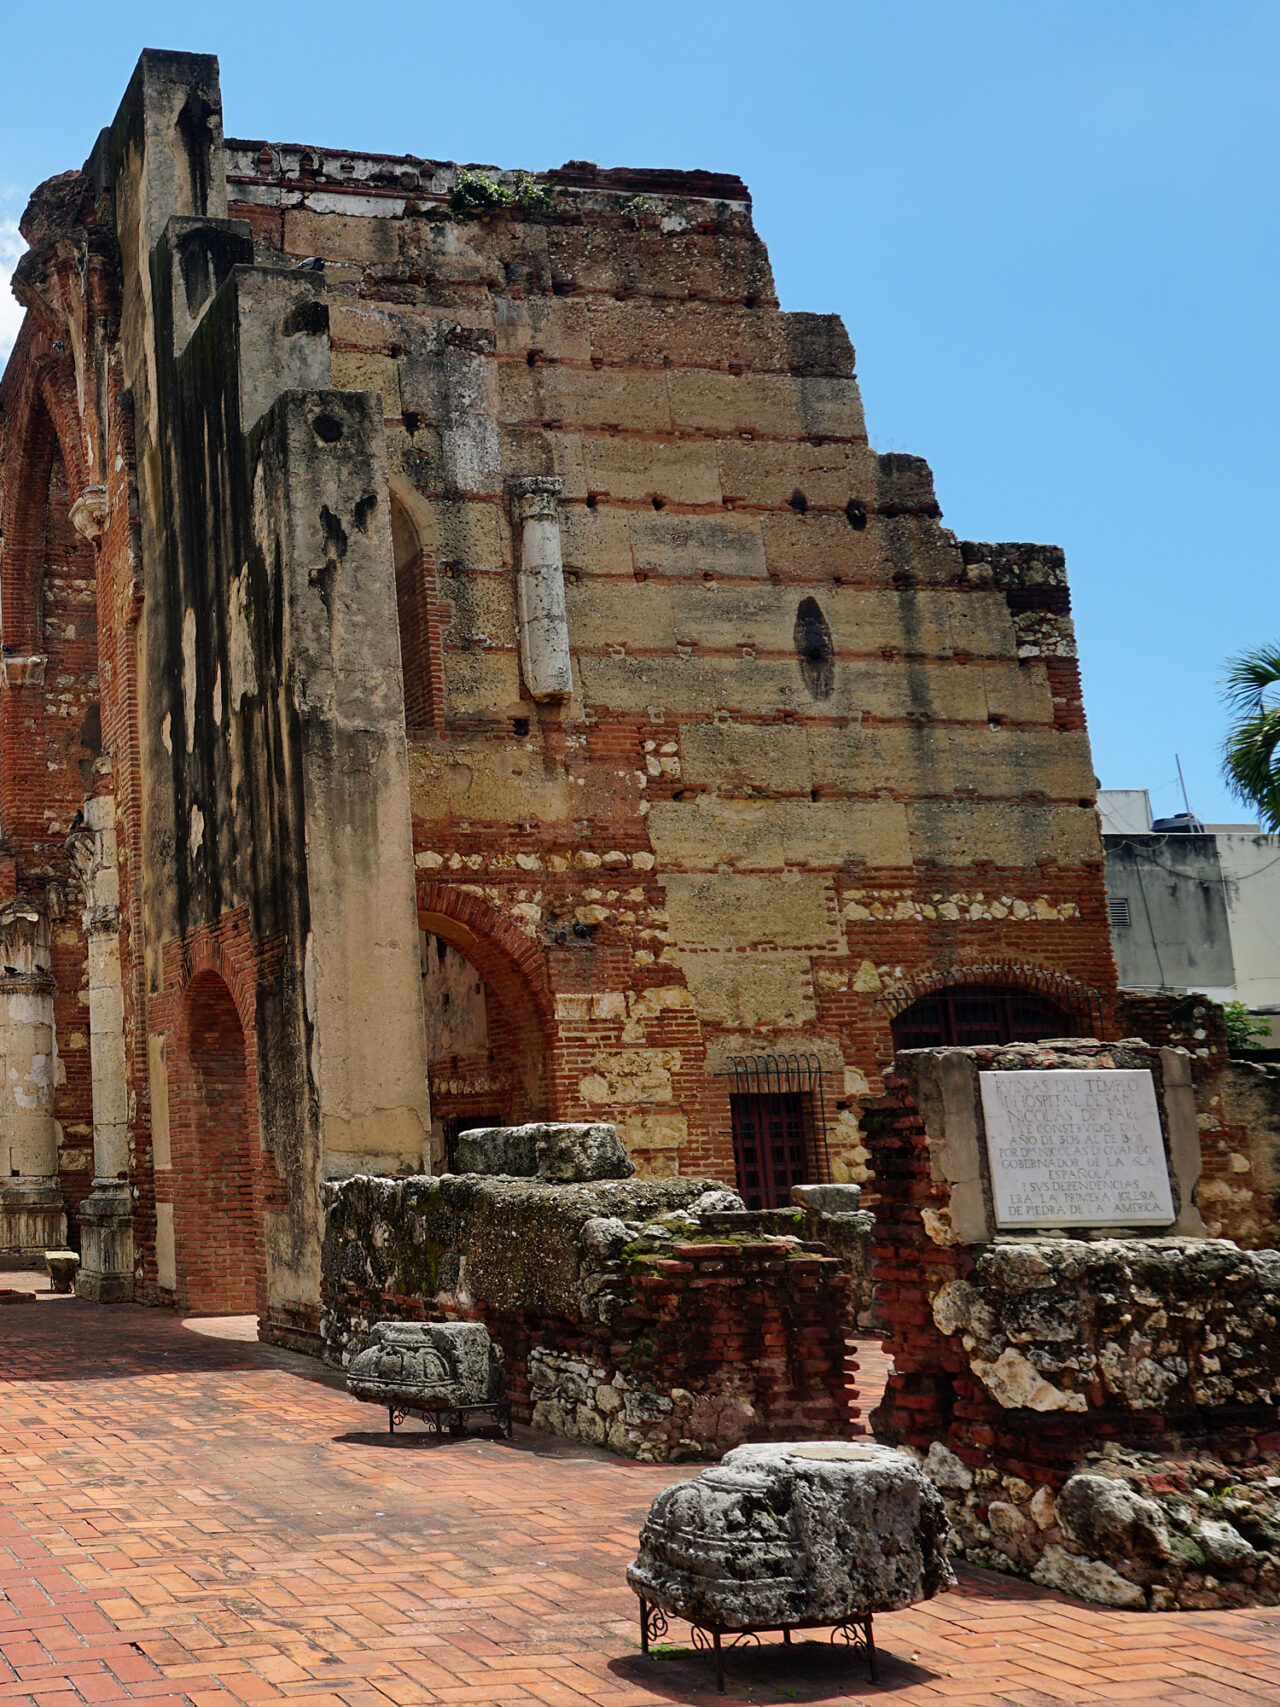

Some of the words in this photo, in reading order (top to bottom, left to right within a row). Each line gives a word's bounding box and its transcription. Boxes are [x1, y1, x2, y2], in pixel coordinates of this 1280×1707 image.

[1013, 1094, 1081, 1108] HOSPITAL
[1085, 1135, 1101, 1145] AL
[1104, 1134, 1118, 1144] DE
[999, 1147, 1019, 1158] POR
[1001, 1158, 1079, 1169] GOBERNADOR
[1087, 1158, 1101, 1168] DE
[1106, 1157, 1124, 1167] LA
[1048, 1167, 1112, 1180] ESPAÑOLA
[1030, 1181, 1050, 1192] SVS
[1053, 1180, 1140, 1192] DEPENDENCIAS
[1010, 1194, 1034, 1205] ERA
[1041, 1193, 1057, 1204] LA
[1064, 1192, 1111, 1204] PRIMERA
[1118, 1190, 1157, 1202] IGLESIA
[1009, 1205, 1024, 1217] DE
[1026, 1204, 1065, 1216] PIEDRA
[1070, 1204, 1083, 1215] DE
